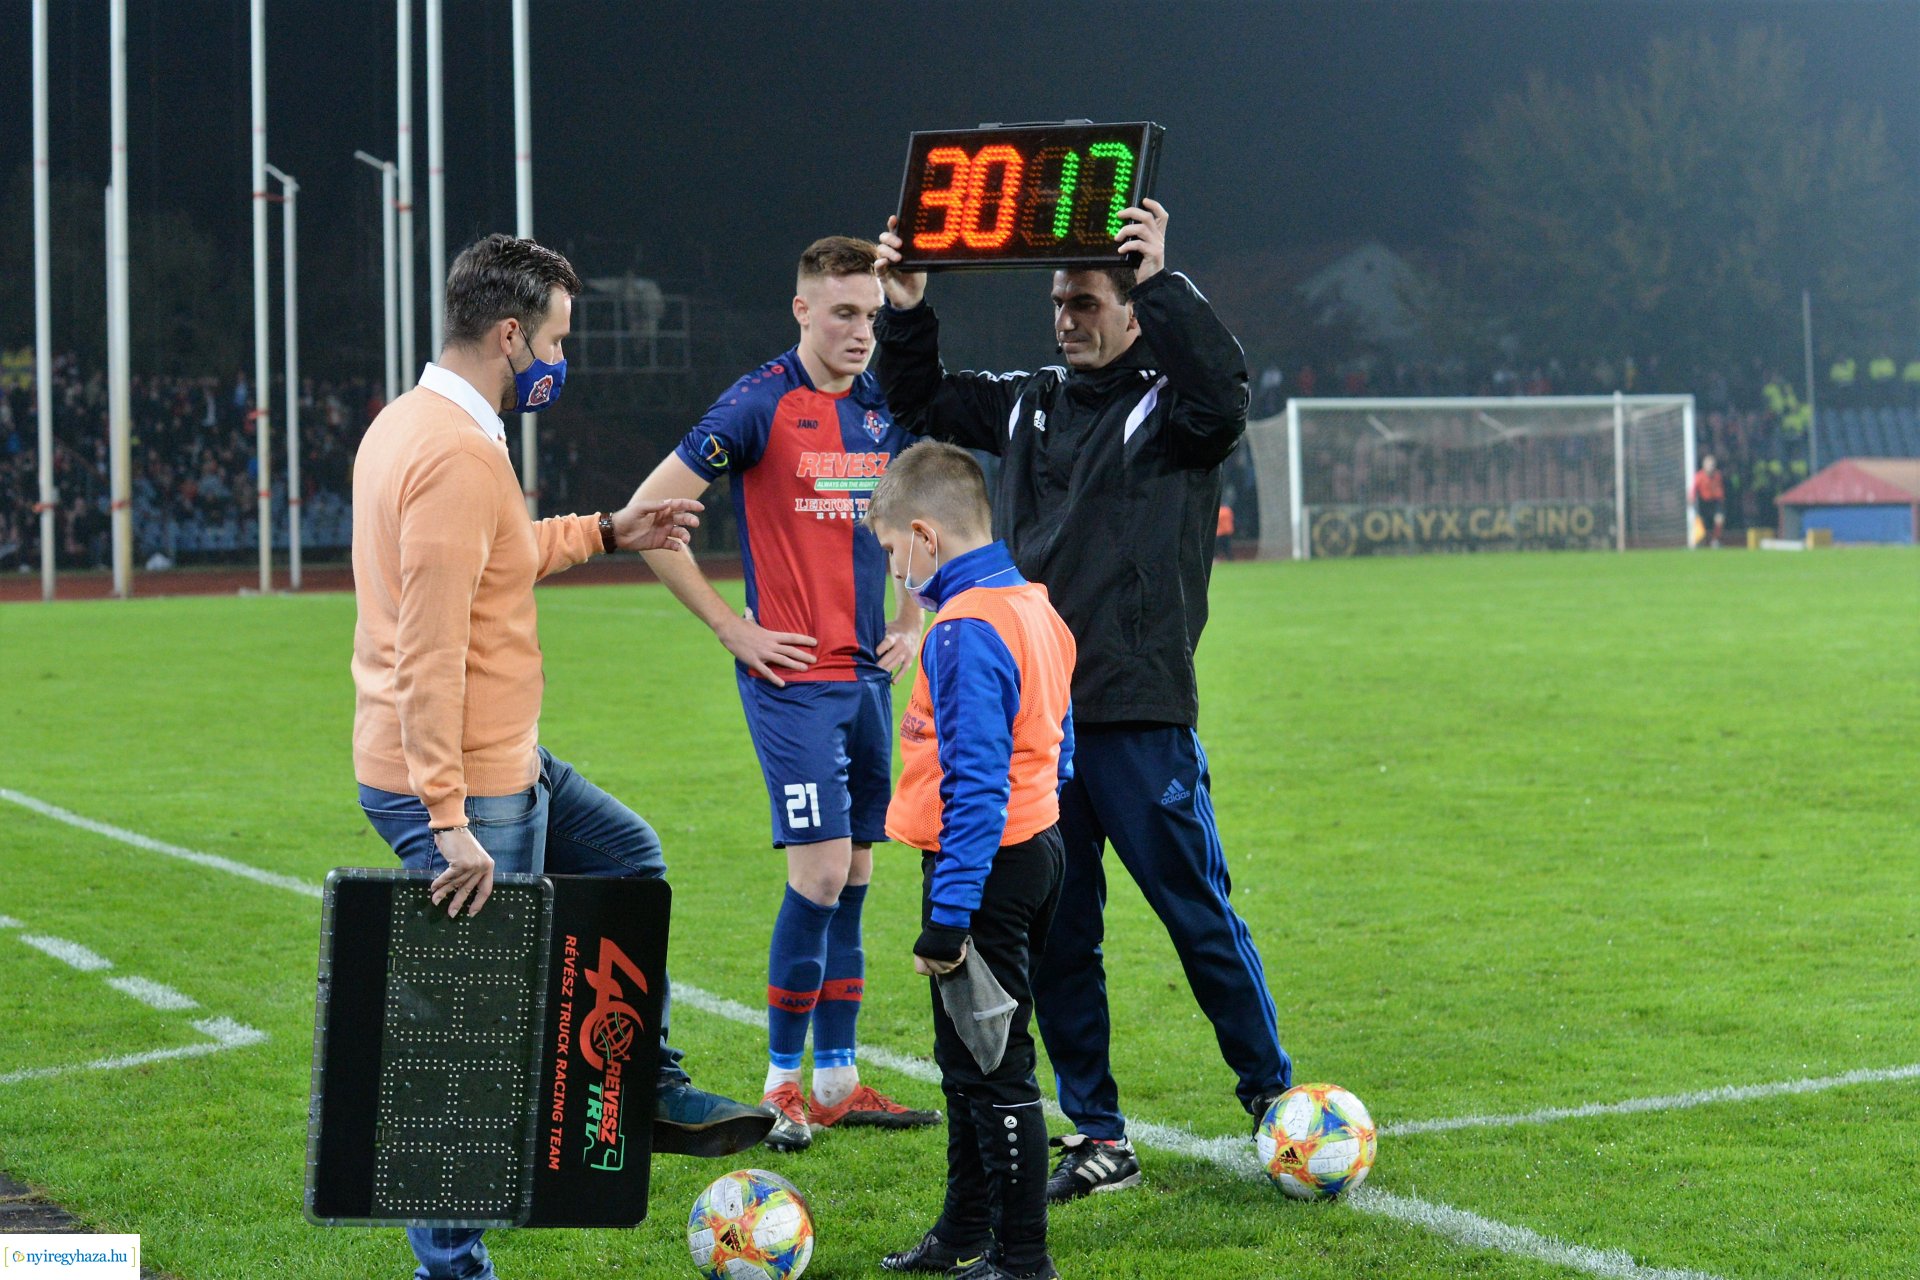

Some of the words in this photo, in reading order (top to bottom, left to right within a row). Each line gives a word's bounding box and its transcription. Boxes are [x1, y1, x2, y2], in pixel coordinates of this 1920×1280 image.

[913, 145, 1024, 249] 30
[1052, 141, 1134, 239] 17
[796, 452, 891, 478] REVESZ
[795, 499, 854, 512] LERTON
[855, 499, 870, 511] TR
[1363, 509, 1462, 541] ONYX
[784, 783, 821, 828] 21
[1161, 790, 1191, 805] adidas
[561, 934, 580, 998] RÉVÉSZ
[556, 1001, 572, 1056] TRUCK
[552, 1058, 568, 1123] RACING
[600, 1060, 622, 1146] REVESZ
[548, 1127, 563, 1170] TEAM
